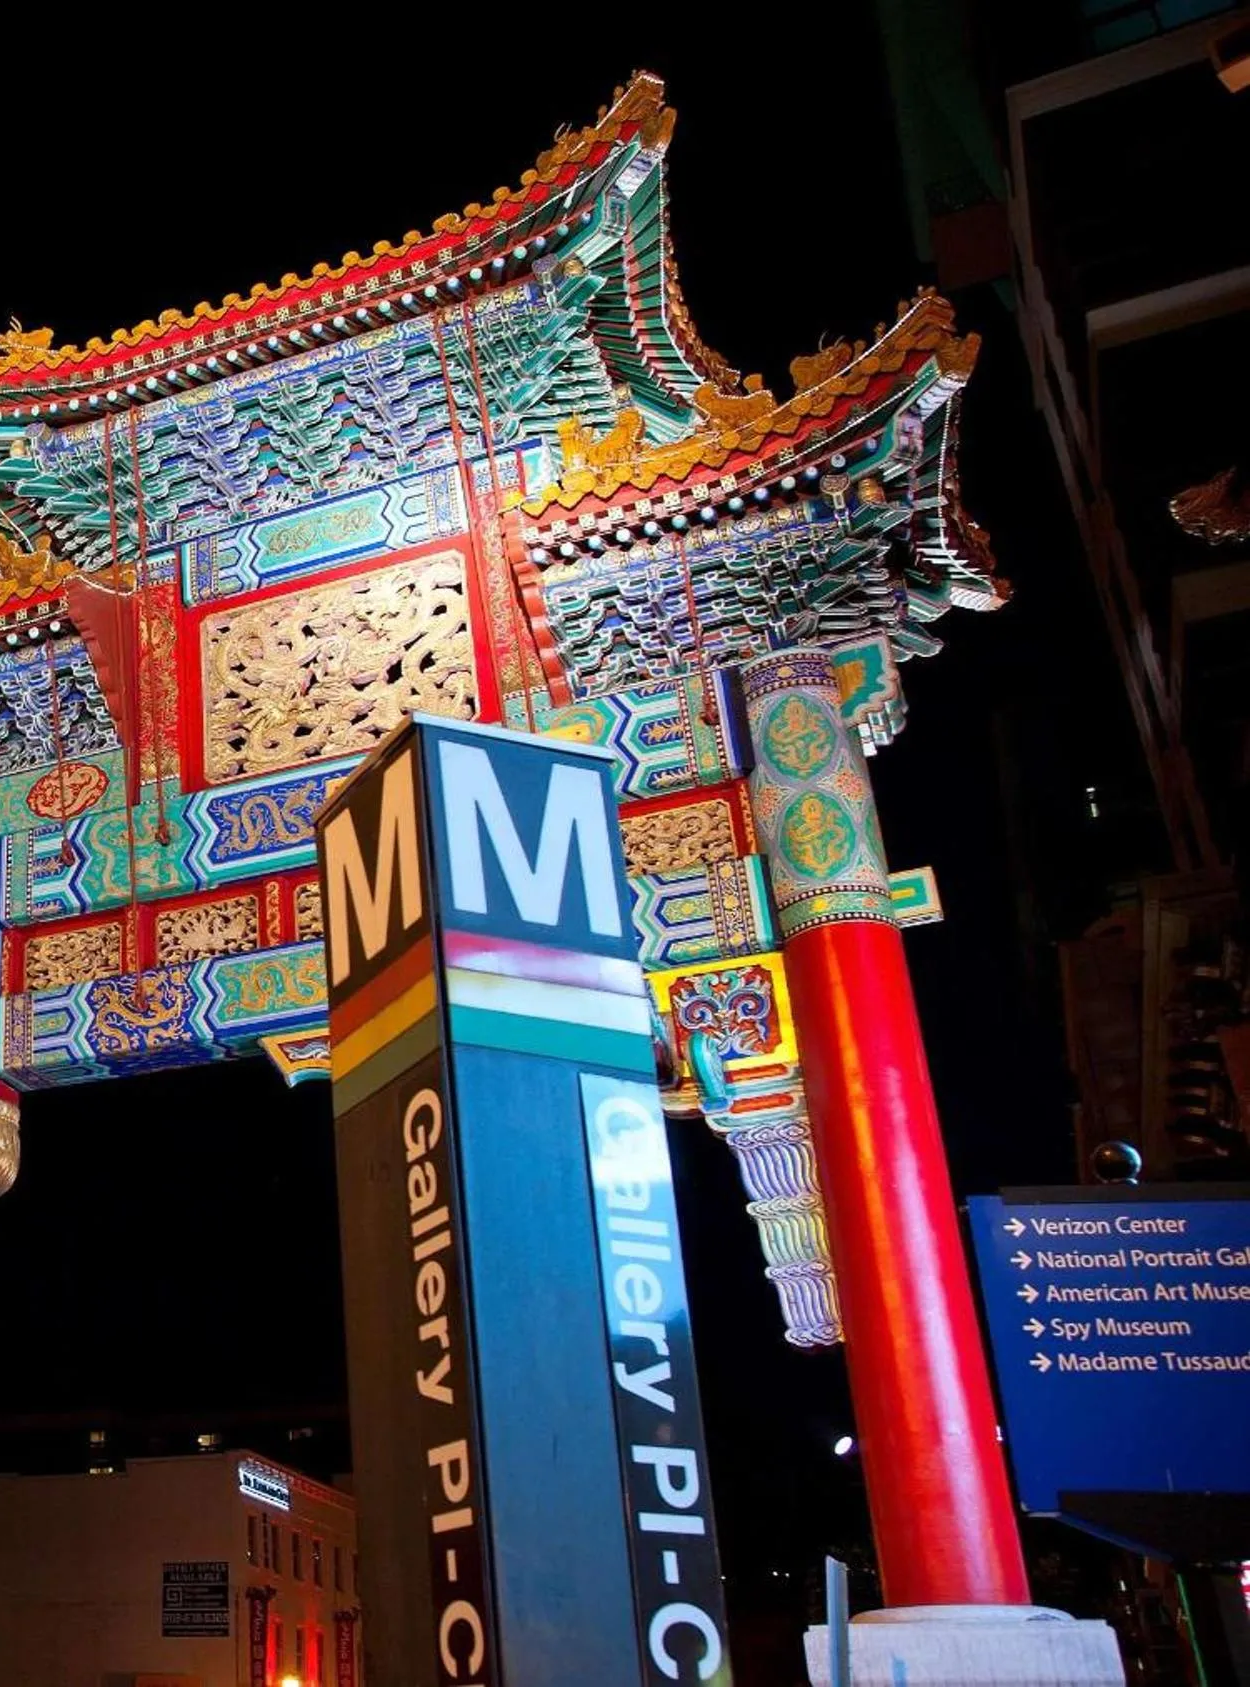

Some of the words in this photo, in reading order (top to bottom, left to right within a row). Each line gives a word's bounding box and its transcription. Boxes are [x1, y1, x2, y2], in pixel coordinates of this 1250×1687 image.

[438, 739, 622, 938] M
[324, 748, 422, 987] M
[1030, 1218, 1110, 1235] Verizon
[1115, 1216, 1186, 1234] Center
[402, 1088, 454, 1405] Gallery
[593, 1095, 676, 1413] Gallery
[1037, 1250, 1126, 1268] National
[1131, 1248, 1212, 1267] Portrait
[1046, 1284, 1148, 1301] American
[1154, 1283, 1188, 1301] Art
[1193, 1282, 1250, 1300] Muse
[1051, 1318, 1091, 1341] Spy
[1095, 1318, 1191, 1336] Museum
[1058, 1352, 1158, 1371] Madame
